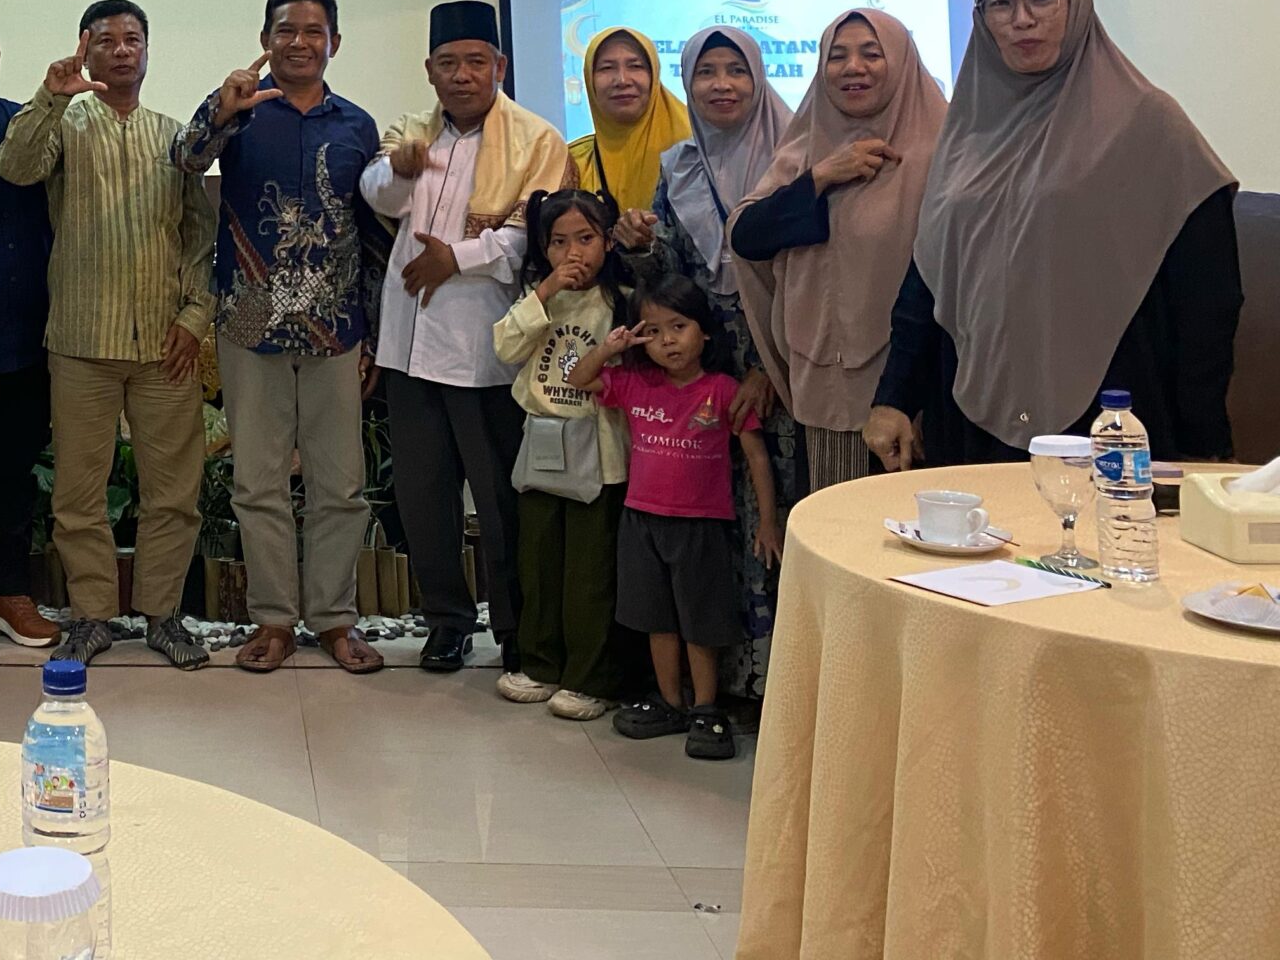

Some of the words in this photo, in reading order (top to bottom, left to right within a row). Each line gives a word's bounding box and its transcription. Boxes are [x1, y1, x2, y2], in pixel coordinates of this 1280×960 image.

[714, 15, 727, 24] EL
[730, 14, 780, 24] PARADISE
[538, 338, 556, 372] GOOD
[555, 324, 597, 347] NIGHT
[549, 397, 582, 407] RESEARCH
